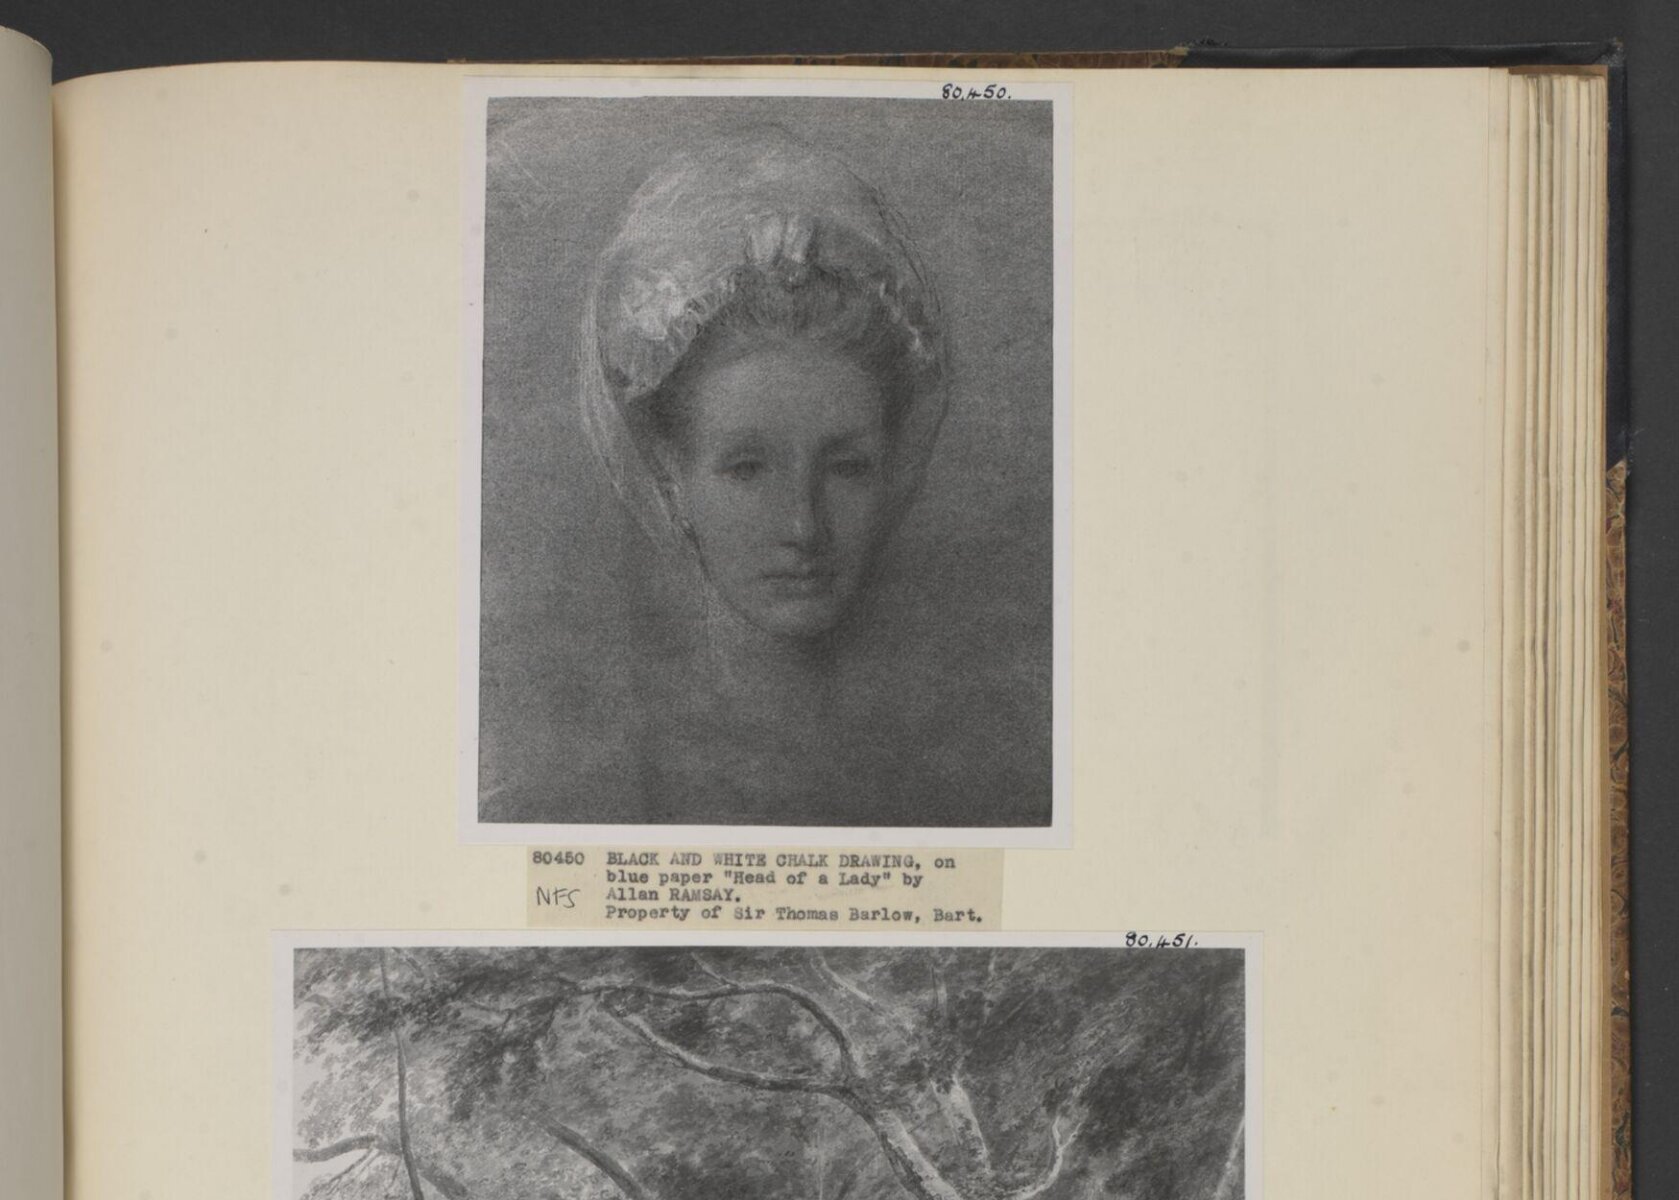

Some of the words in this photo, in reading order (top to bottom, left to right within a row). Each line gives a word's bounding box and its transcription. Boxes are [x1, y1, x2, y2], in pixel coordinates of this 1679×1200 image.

[532, 851, 586, 865] 80450
[605, 852, 660, 866] BLACK
[669, 853, 703, 866] AND
[713, 853, 768, 867] WHITE
[775, 854, 830, 868] CHALK
[838, 854, 922, 870] DRAWING,
[933, 857, 957, 868] on
[606, 870, 650, 883] blue
[658, 872, 713, 886] paper
[723, 871, 777, 884] "Head
[785, 872, 808, 885] of
[817, 874, 829, 885] a
[838, 872, 892, 887] Lady"
[902, 873, 924, 888] by
[536, 886, 582, 908] NFS
[605, 888, 660, 900] Allan
[668, 888, 742, 902] RAMSAY.
[605, 905, 691, 921] Property
[700, 906, 723, 918] of
[733, 907, 766, 920] Sir
[775, 907, 840, 920] Thomas
[848, 908, 922, 923] Barlow,
[933, 909, 983, 923] Bart.
